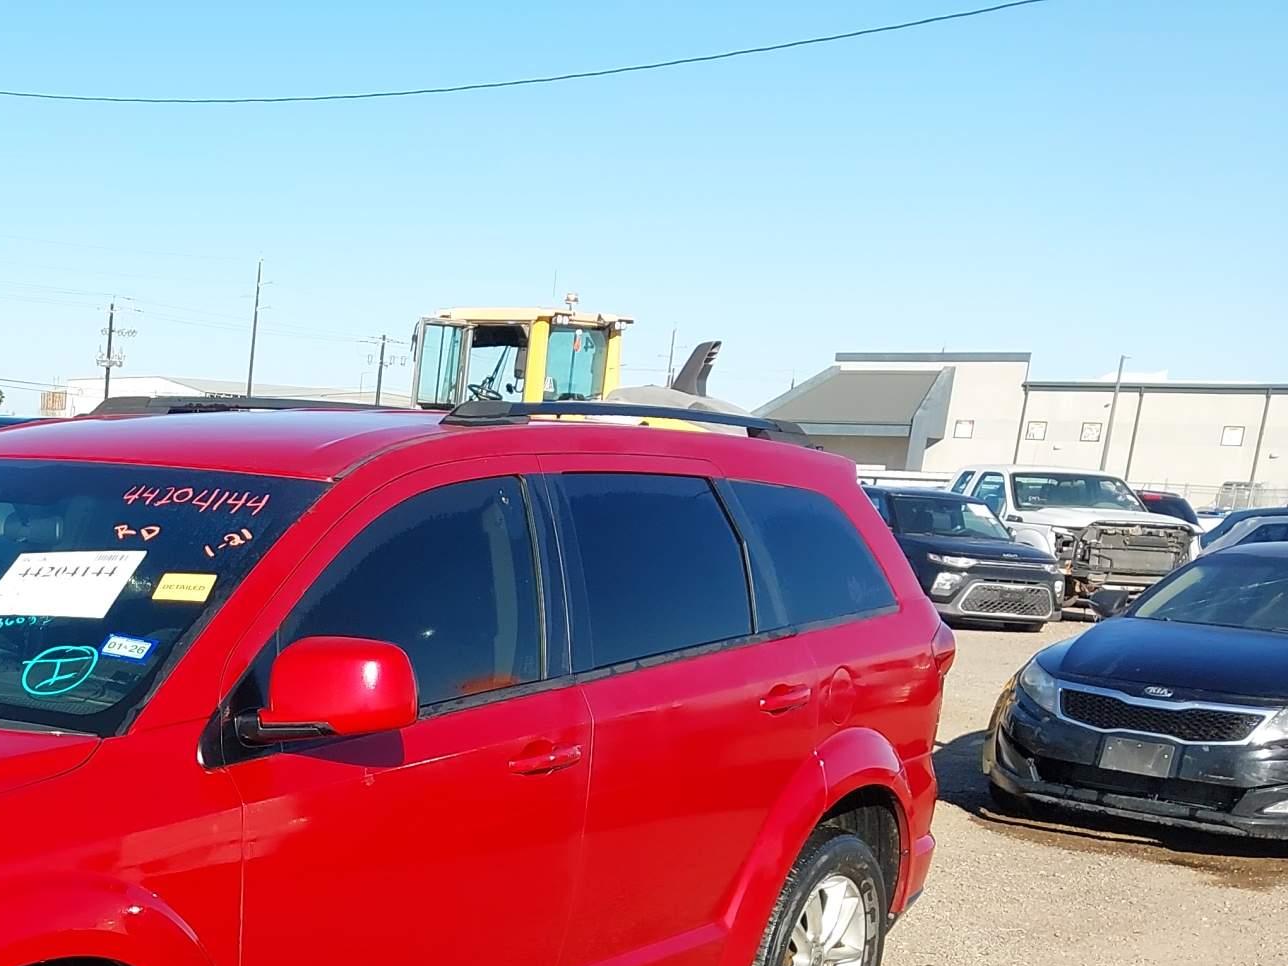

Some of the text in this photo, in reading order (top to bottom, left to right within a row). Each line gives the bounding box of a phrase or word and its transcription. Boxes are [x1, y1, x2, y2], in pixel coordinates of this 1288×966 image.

[17, 566, 118, 578] 44204144
[161, 583, 206, 591] DETAILED
[1145, 686, 1170, 697] KIA
